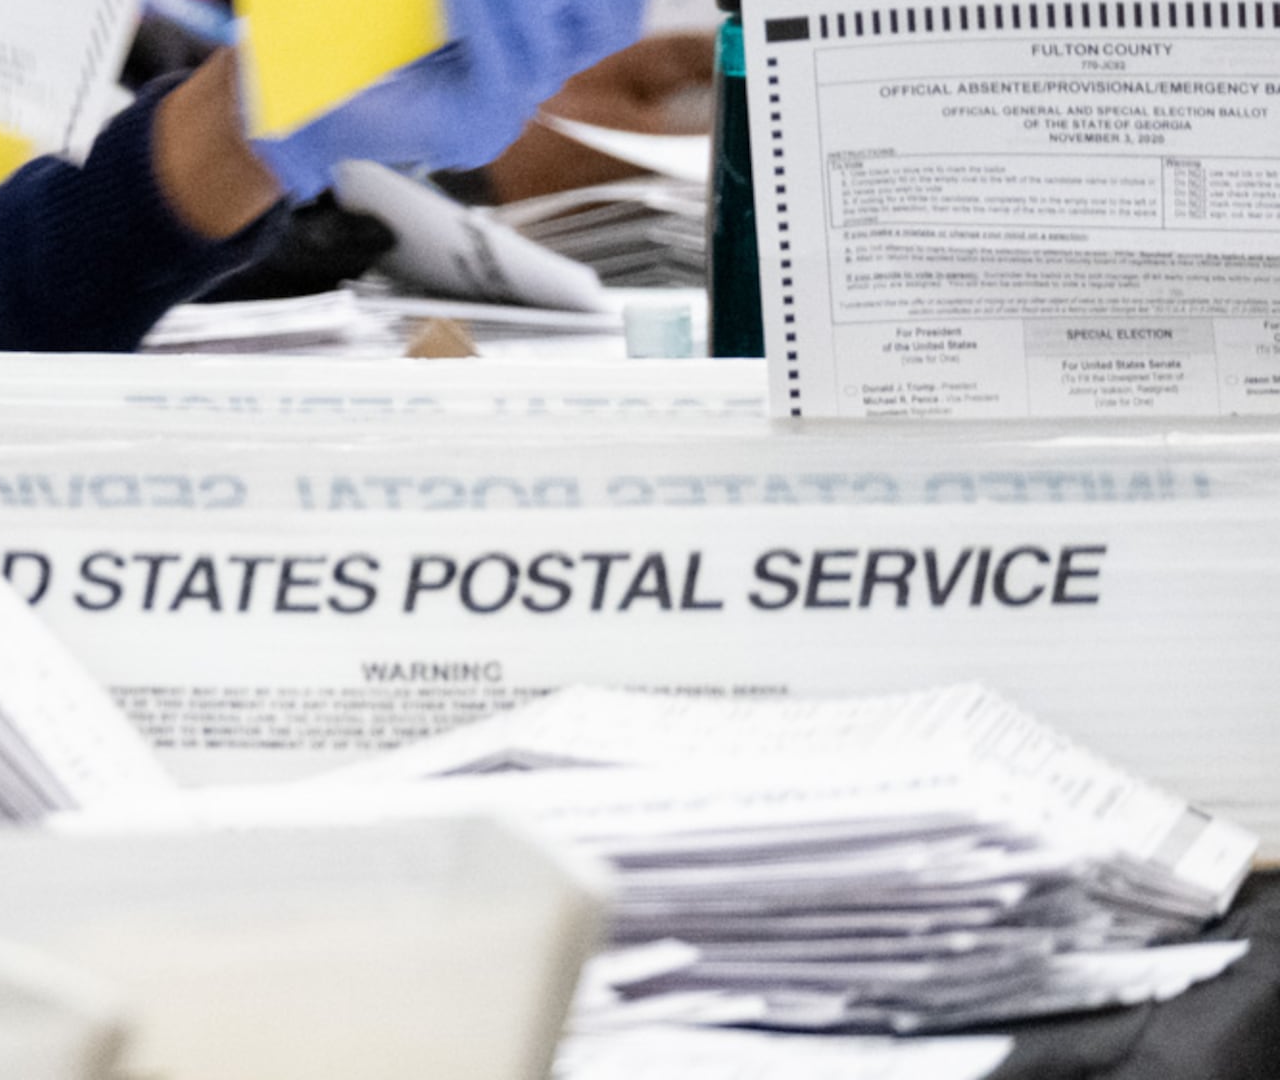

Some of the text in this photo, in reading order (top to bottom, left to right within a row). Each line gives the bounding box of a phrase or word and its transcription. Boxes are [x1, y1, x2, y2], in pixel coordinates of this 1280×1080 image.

[1032, 42, 1173, 57] FULTON COUNTY
[879, 85, 952, 98] OFFICIAL
[958, 80, 1260, 96] ABSENTEE/PROVISIONAL/EMERGENCY
[942, 106, 1268, 119] OFFICIAL GENERAL AND SPECIAL ELECTION BALLOT
[1023, 119, 1192, 130] OF THE STATE OF GEORGIA
[1049, 133, 1165, 145] NOVEMBER 3, 2020
[896, 326, 962, 338] For President
[1066, 329, 1173, 340] SPECIAL ELECTION
[882, 341, 978, 352] of the United States
[1061, 360, 1182, 371] For United States Senate
[73, 550, 380, 614] STATES
[402, 549, 723, 615] POSTAL
[747, 544, 1108, 609] SERVICE
[361, 660, 504, 683] WARNING
